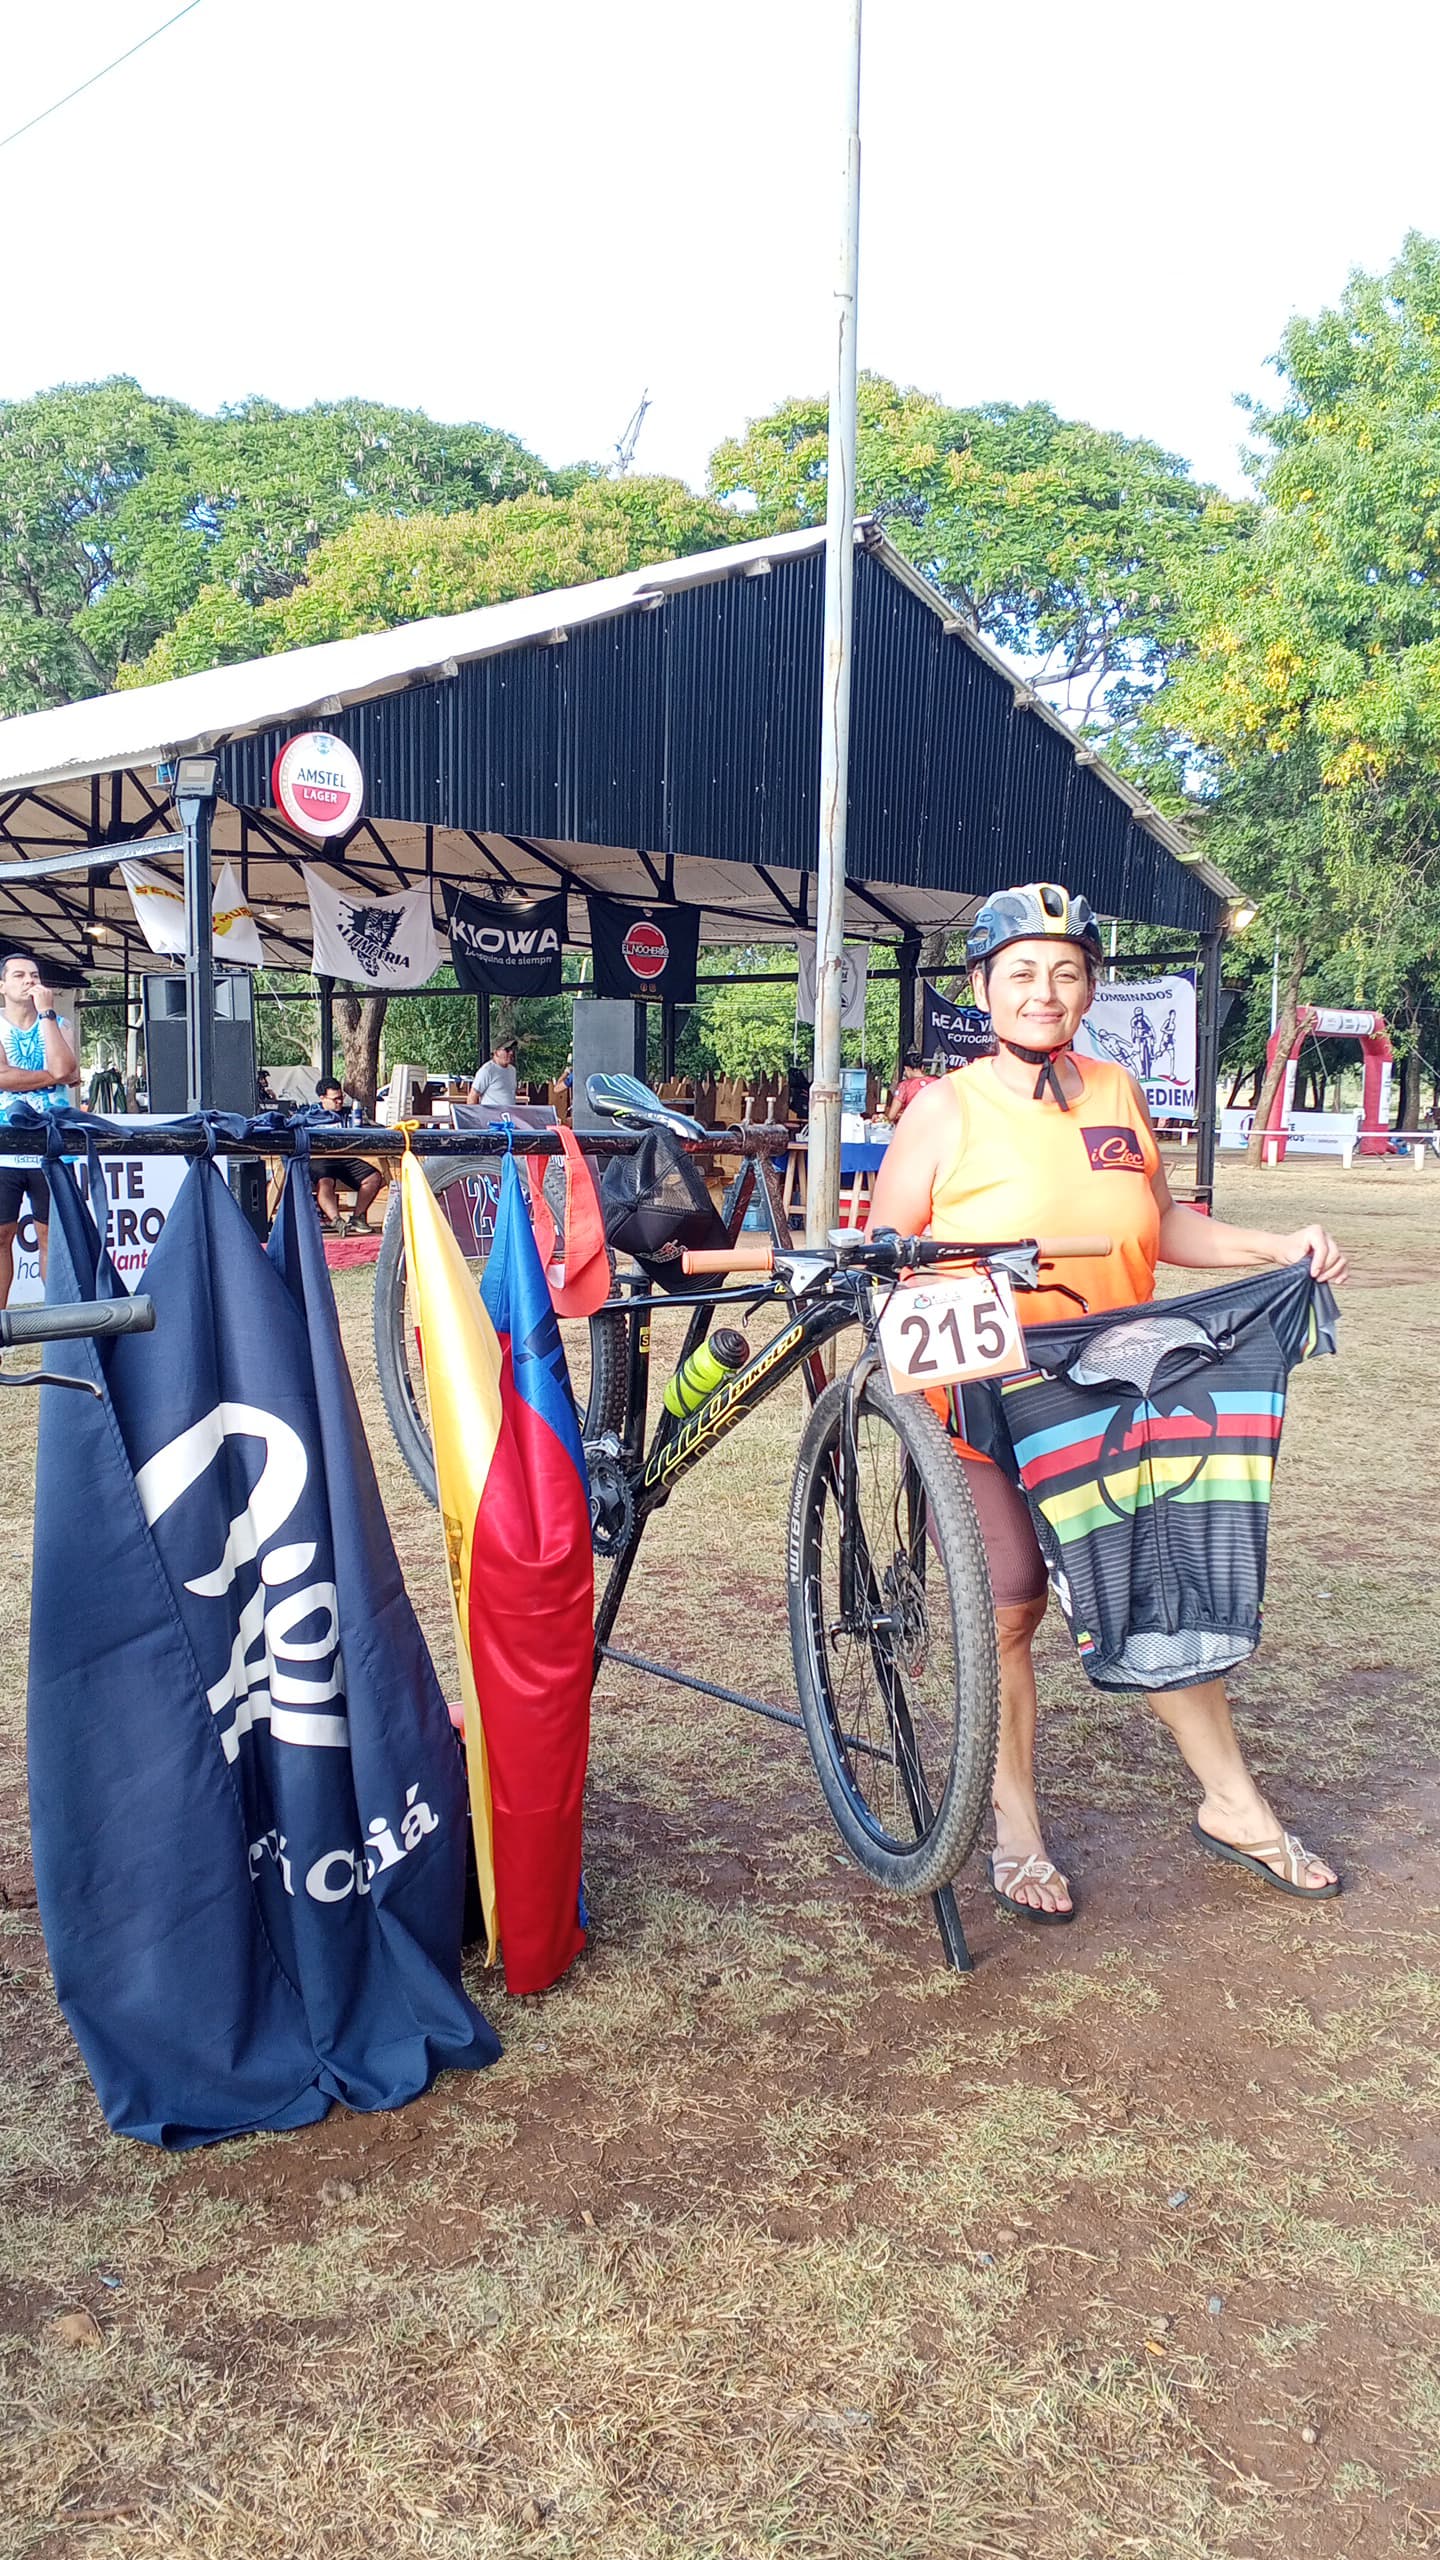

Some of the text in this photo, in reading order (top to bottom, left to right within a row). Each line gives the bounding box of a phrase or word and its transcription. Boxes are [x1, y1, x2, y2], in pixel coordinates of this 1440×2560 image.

[297, 767, 346, 788] AMSTEL
[303, 788, 338, 804] LAGER
[450, 916, 560, 954] KIOWA
[505, 957, 517, 965] de
[1093, 988, 1173, 1002] COMBINADOS
[931, 1011, 975, 1032] REAL
[900, 1301, 1006, 1375] 215
[792, 1473, 807, 1518] RANGER
